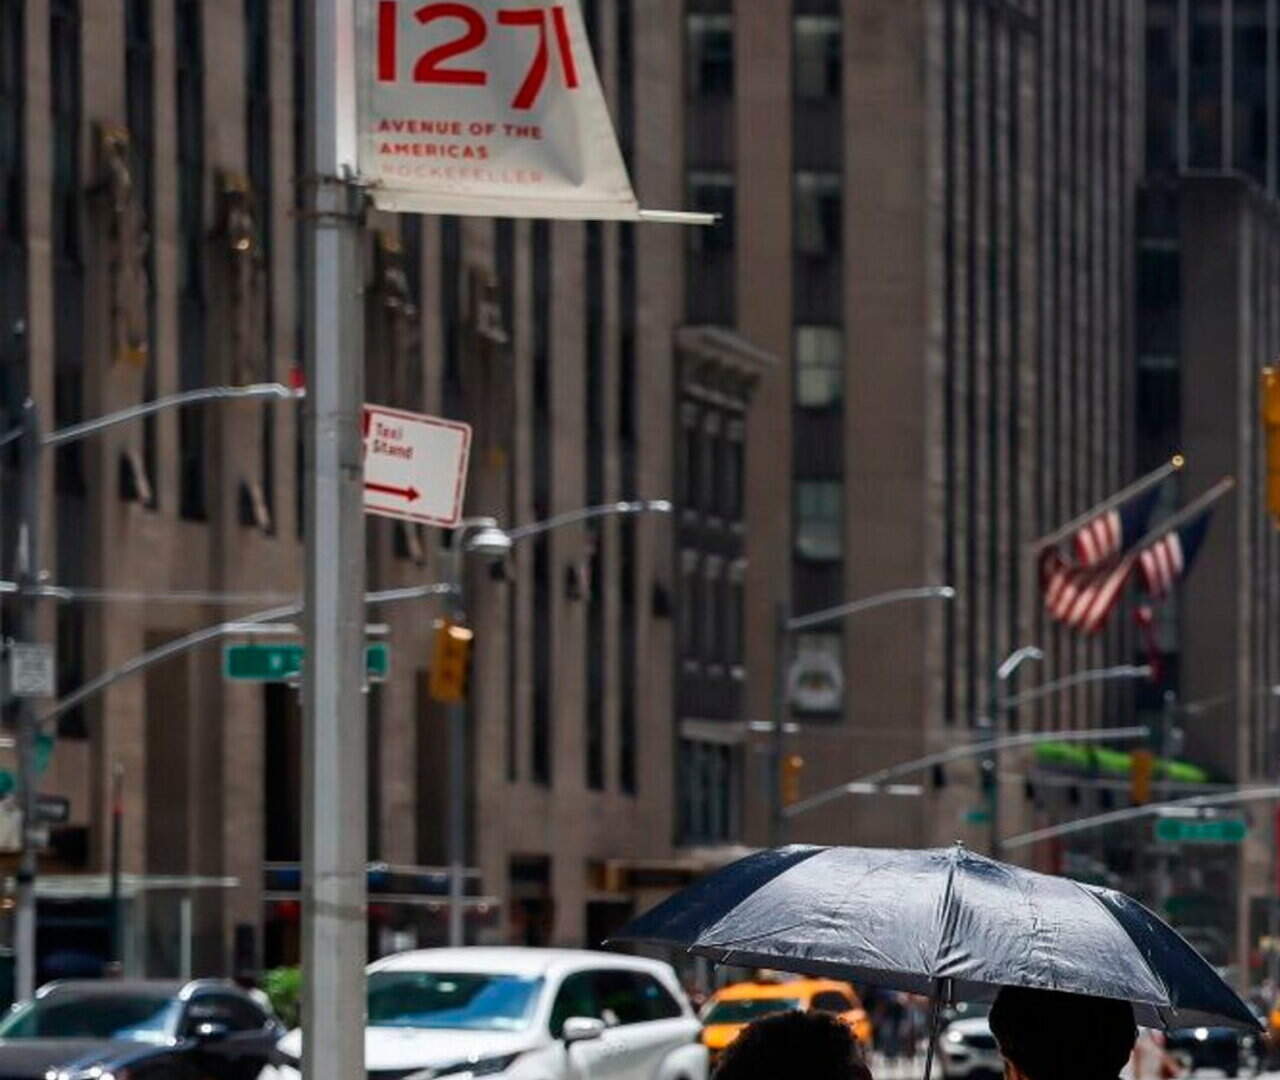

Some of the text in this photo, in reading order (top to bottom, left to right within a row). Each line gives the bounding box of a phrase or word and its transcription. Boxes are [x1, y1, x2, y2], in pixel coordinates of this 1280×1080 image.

[377, 1, 579, 110] 1271
[379, 118, 543, 140] AVENUE OF THE
[379, 142, 489, 159] AMERICAS
